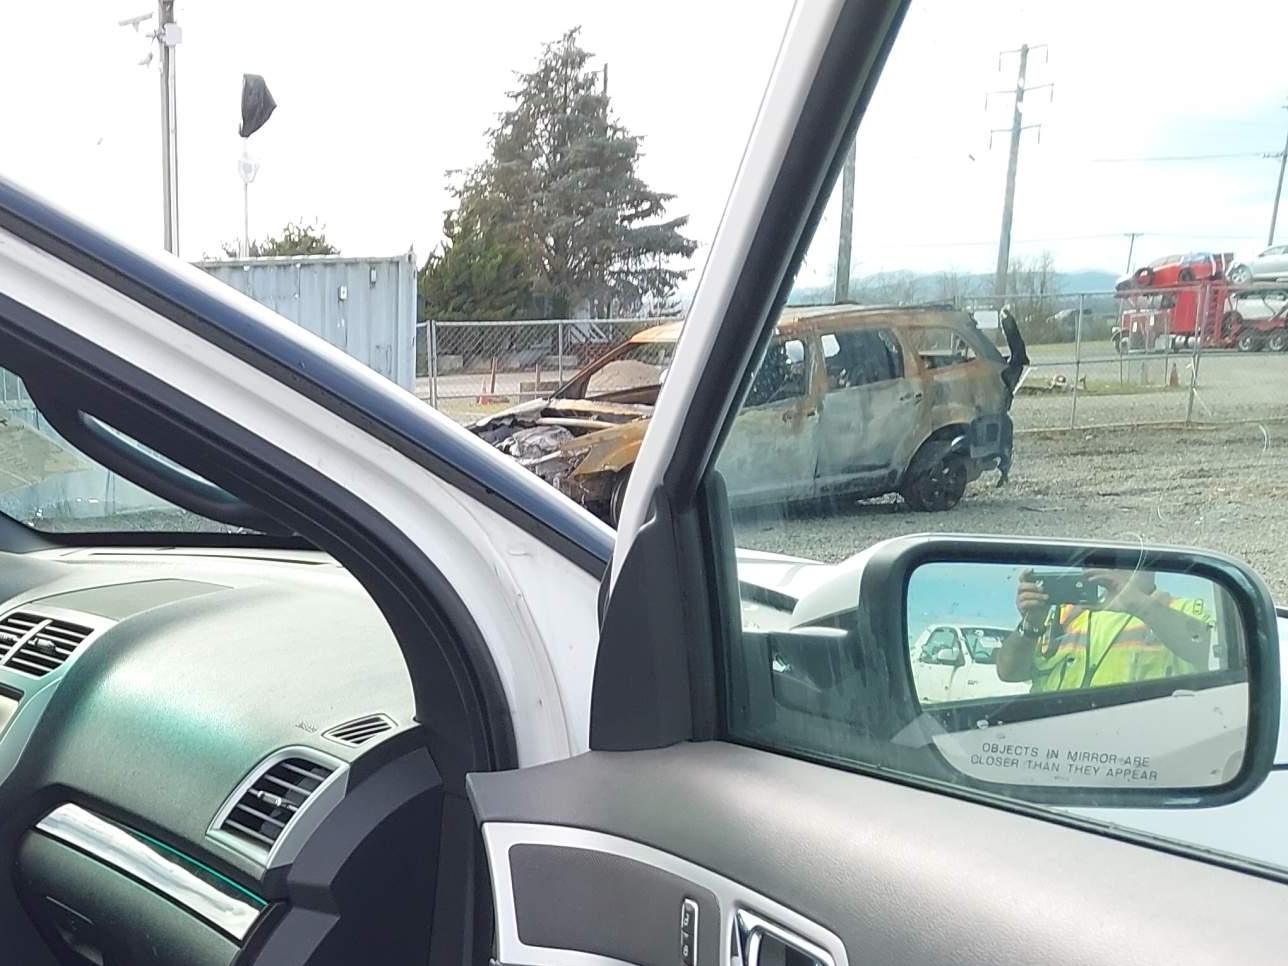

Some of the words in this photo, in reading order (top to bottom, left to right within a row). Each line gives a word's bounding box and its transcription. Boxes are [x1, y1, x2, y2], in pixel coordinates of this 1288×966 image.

[982, 742, 1039, 757] OBJECTS
[1046, 748, 1059, 759] IN
[1066, 751, 1117, 764] MIRROR
[970, 754, 1019, 768] CLOSER
[1026, 760, 1060, 772] THAN
[1068, 763, 1100, 776] THEY
[1106, 768, 1158, 781] APPEAR
